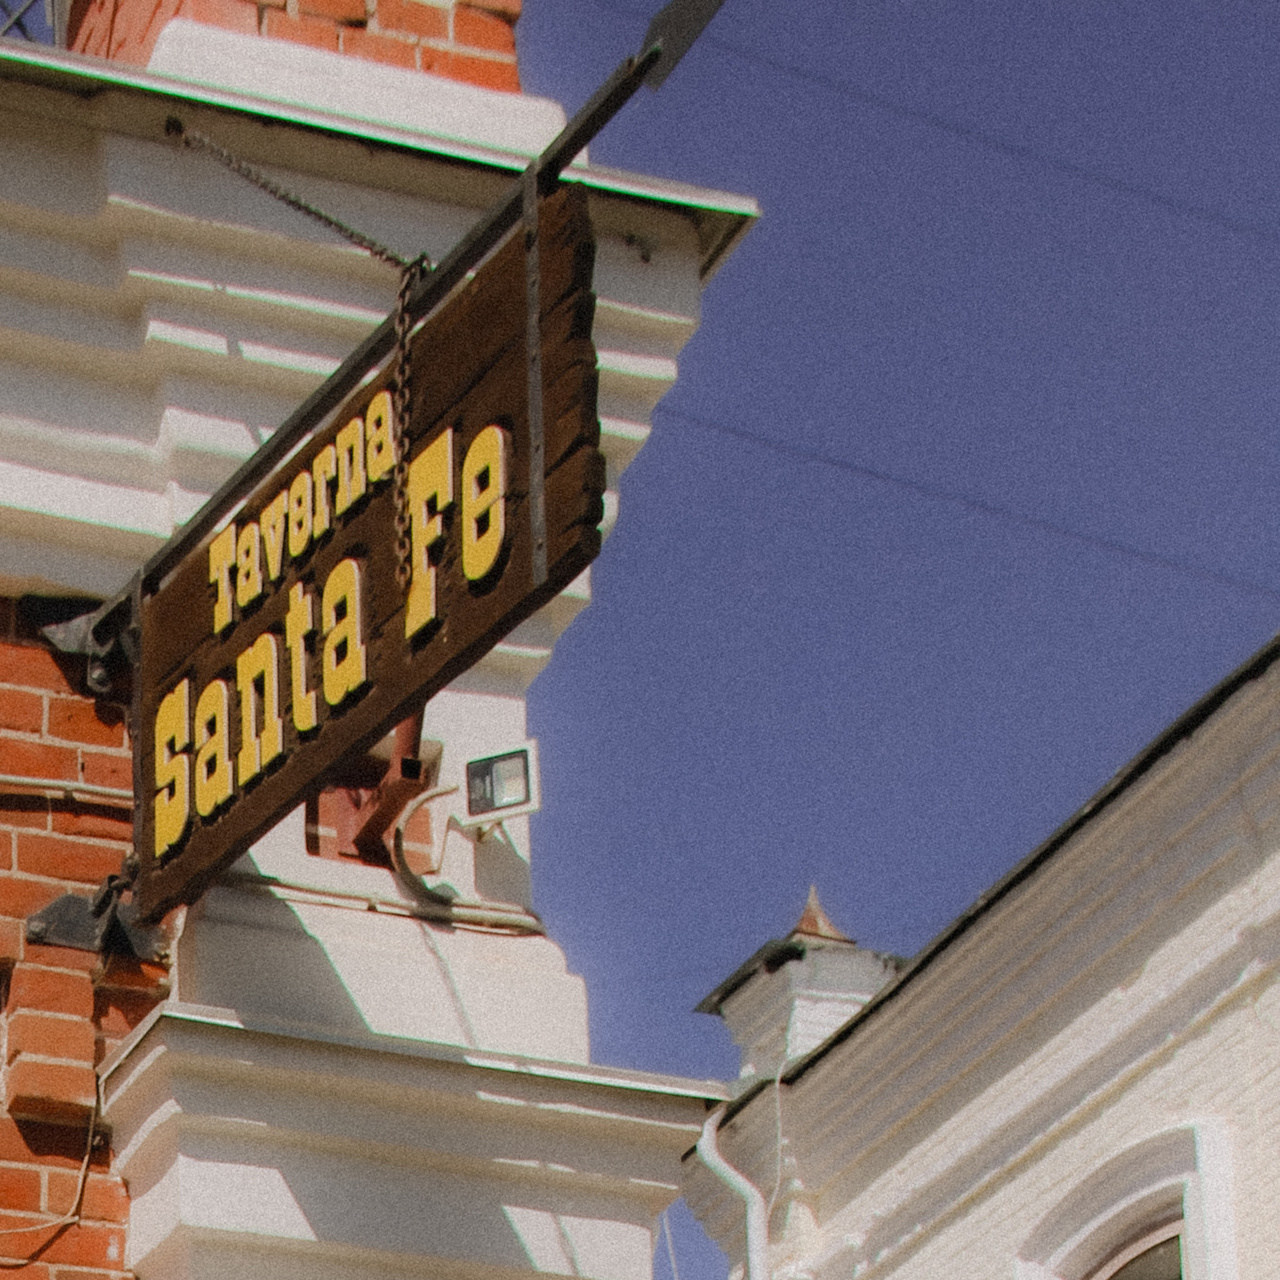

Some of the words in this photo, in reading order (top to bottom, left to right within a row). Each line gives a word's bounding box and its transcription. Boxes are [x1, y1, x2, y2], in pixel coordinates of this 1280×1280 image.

[155, 558, 366, 858] Santa
[405, 424, 505, 639] Fe
[208, 391, 397, 634] Taverna
